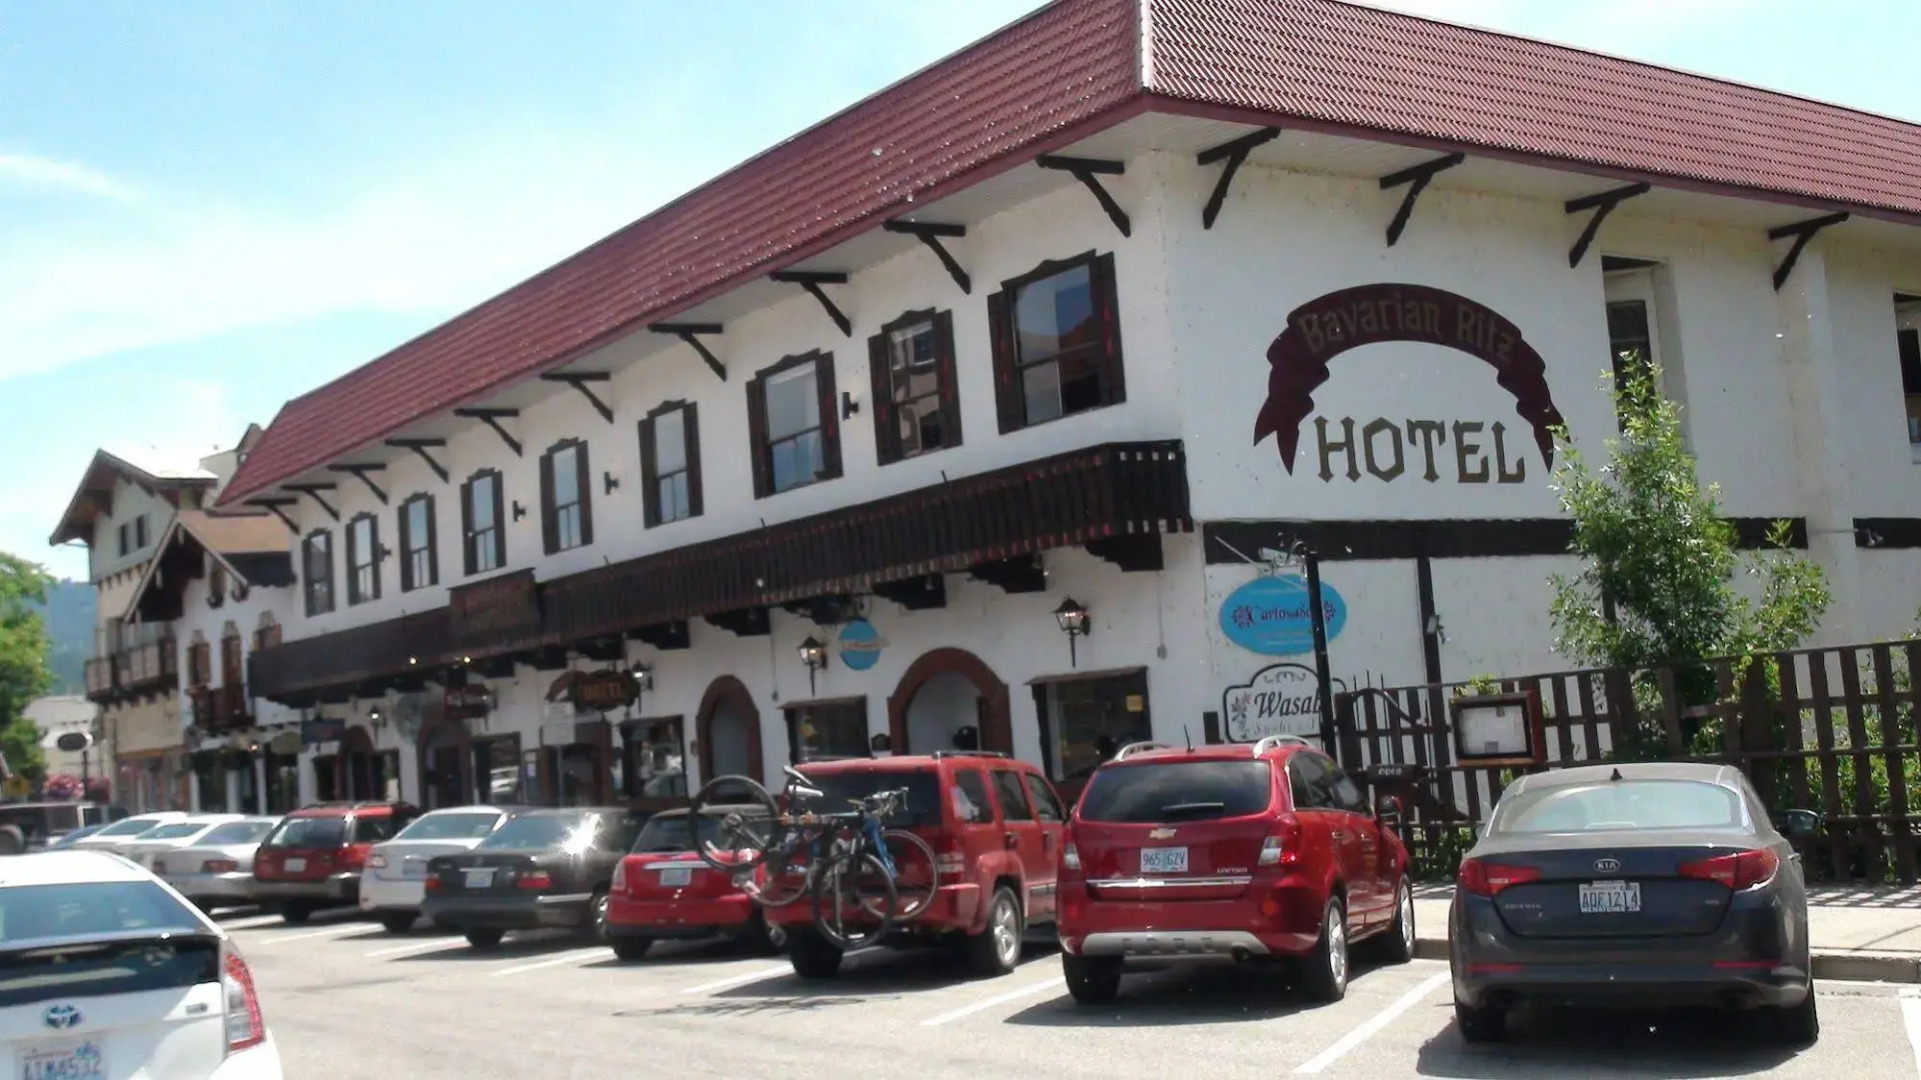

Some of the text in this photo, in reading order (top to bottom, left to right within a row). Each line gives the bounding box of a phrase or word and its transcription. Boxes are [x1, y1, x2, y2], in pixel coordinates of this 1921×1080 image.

[1299, 297, 1514, 363] Bavarian Ritz
[1313, 415, 1525, 484] HOTEL
[1254, 690, 1321, 719] Wasab
[1597, 861, 1616, 869] KIA
